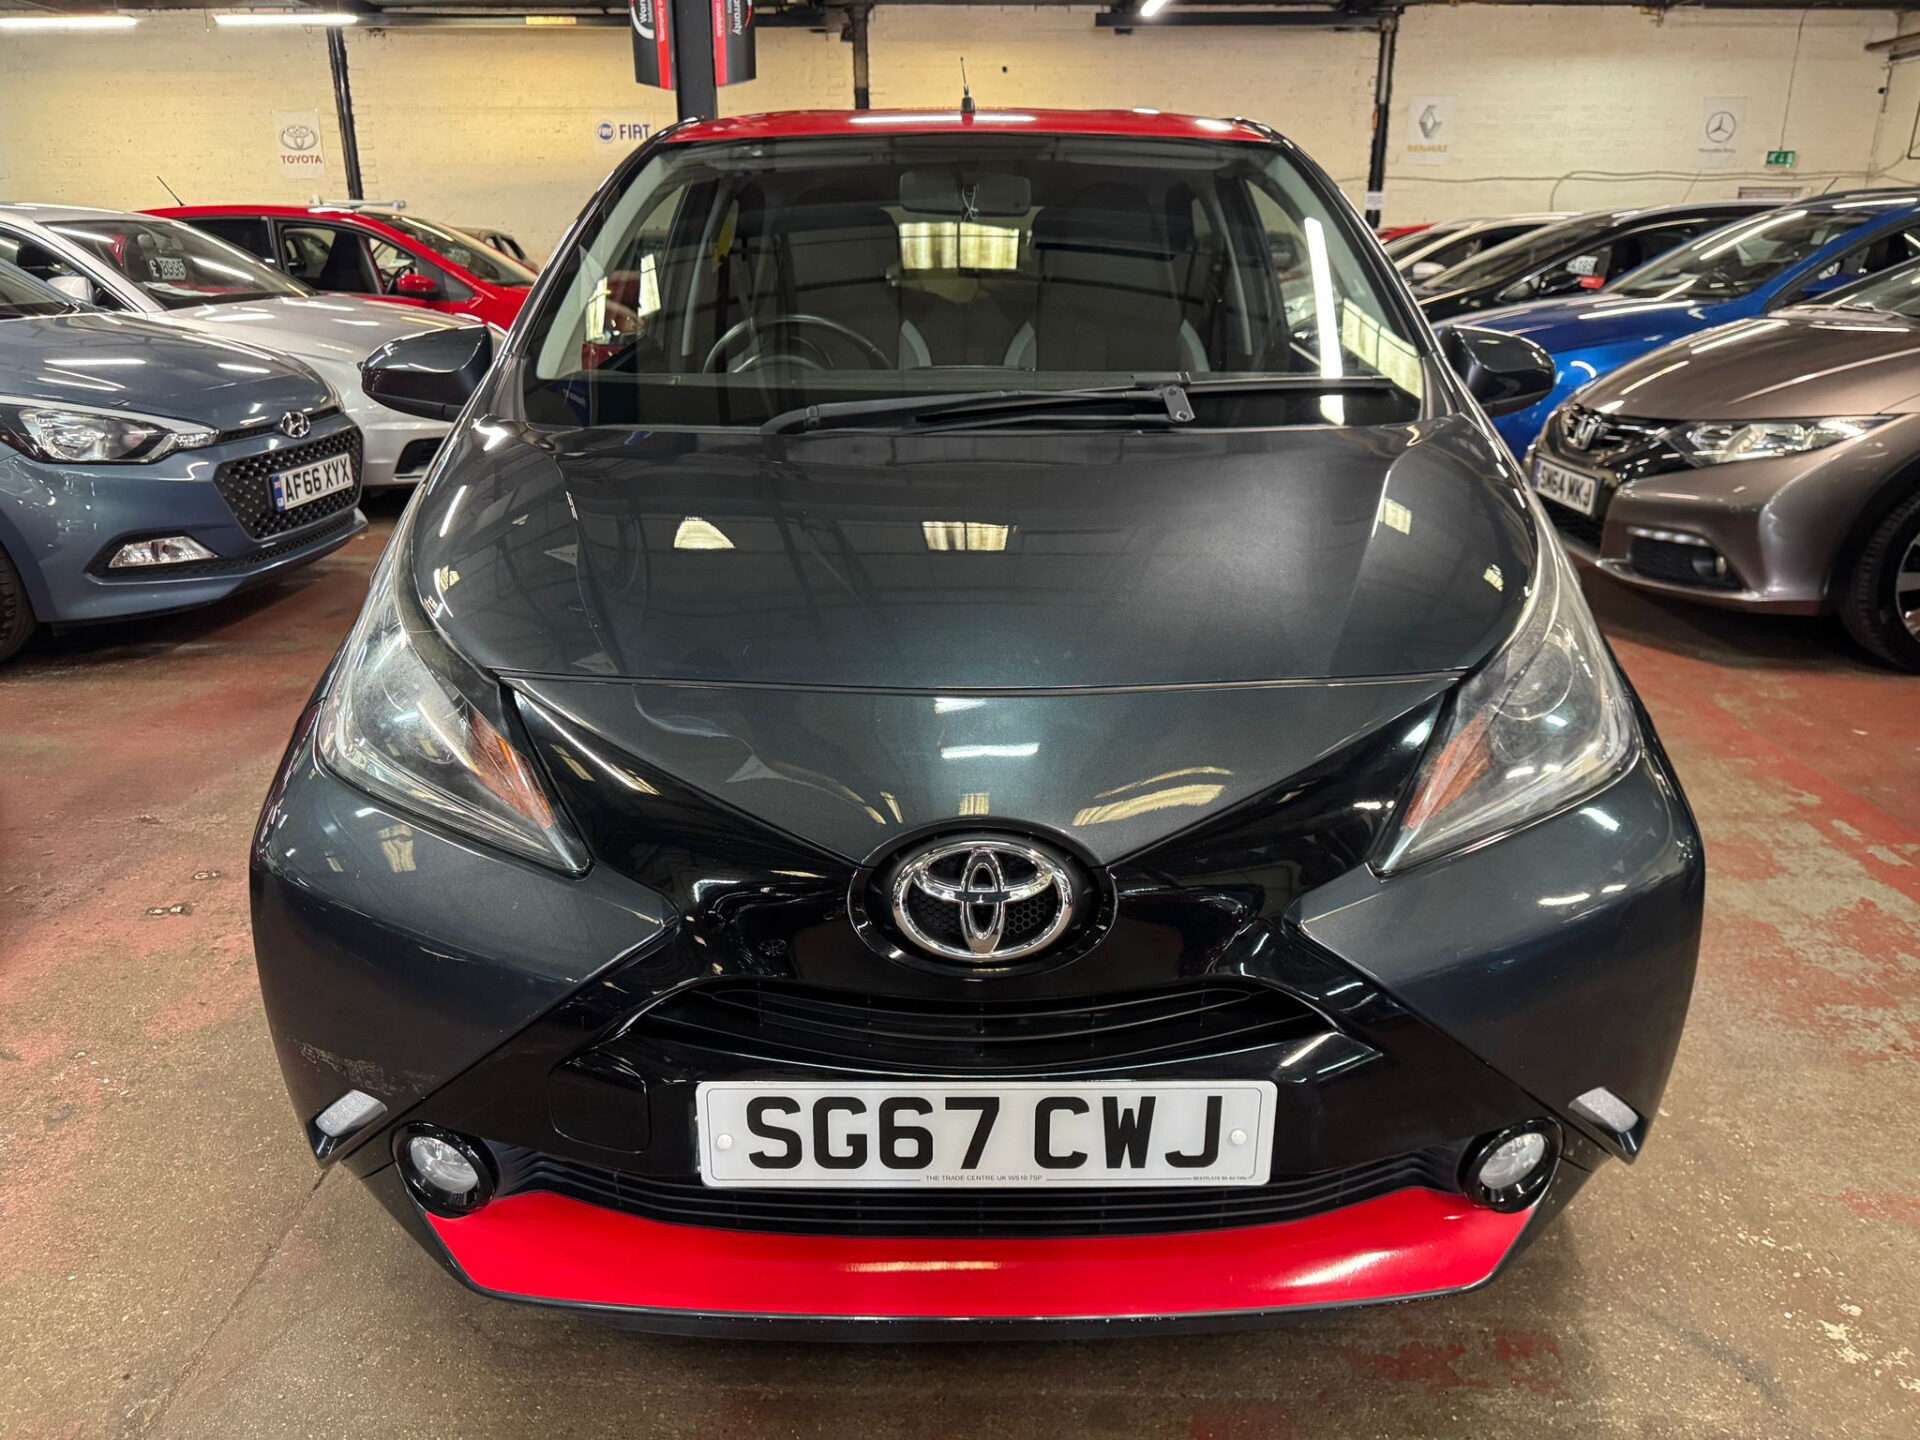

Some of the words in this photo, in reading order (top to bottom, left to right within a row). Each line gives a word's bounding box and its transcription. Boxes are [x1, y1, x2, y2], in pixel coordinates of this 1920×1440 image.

[619, 123, 651, 140] FIAT
[280, 154, 323, 164] TOYOTA
[285, 467, 322, 503] AF66
[323, 457, 351, 489] XYX
[745, 1096, 1000, 1170] SG67
[1033, 1095, 1223, 1169] CWJ
